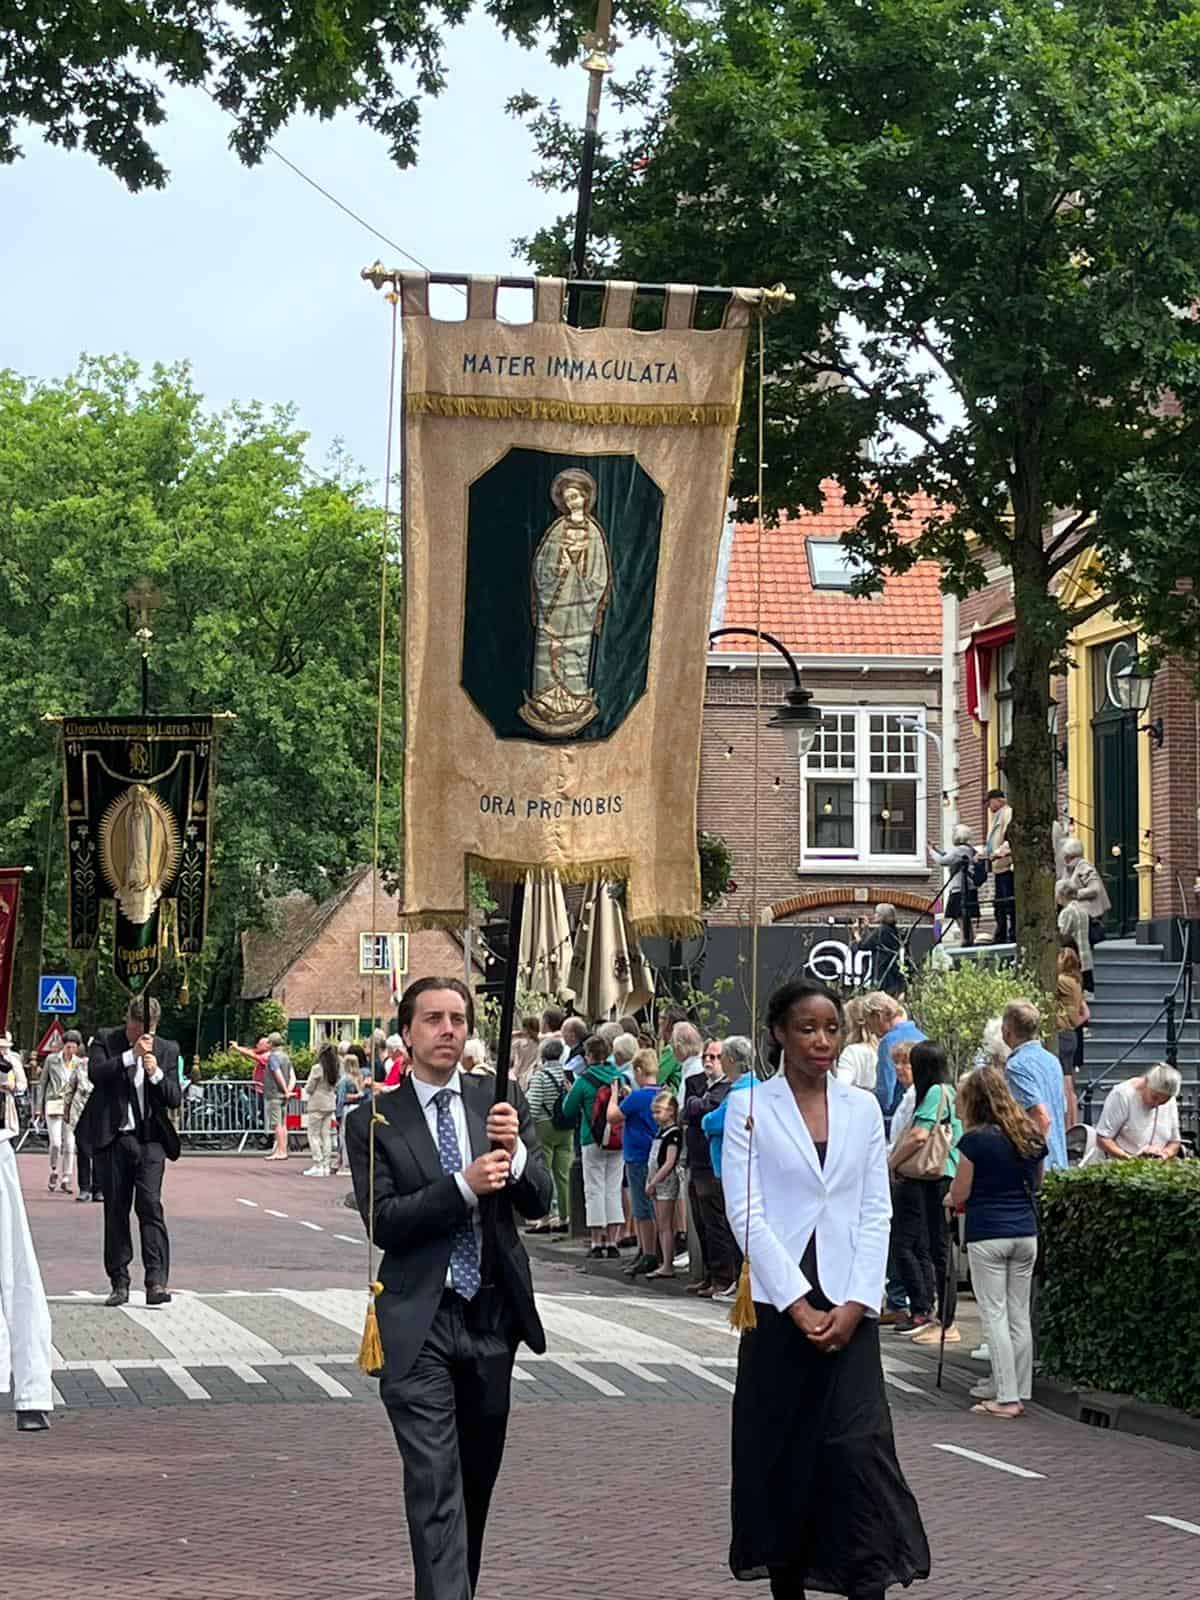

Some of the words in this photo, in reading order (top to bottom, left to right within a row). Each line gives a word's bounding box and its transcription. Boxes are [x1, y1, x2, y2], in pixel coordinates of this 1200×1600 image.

[463, 353, 536, 376] MATER
[547, 355, 679, 384] IMMACULATA
[480, 794, 516, 816] ORA
[527, 799, 562, 819] PRO
[571, 795, 622, 817] NOBIS
[126, 959, 150, 974] 1915
